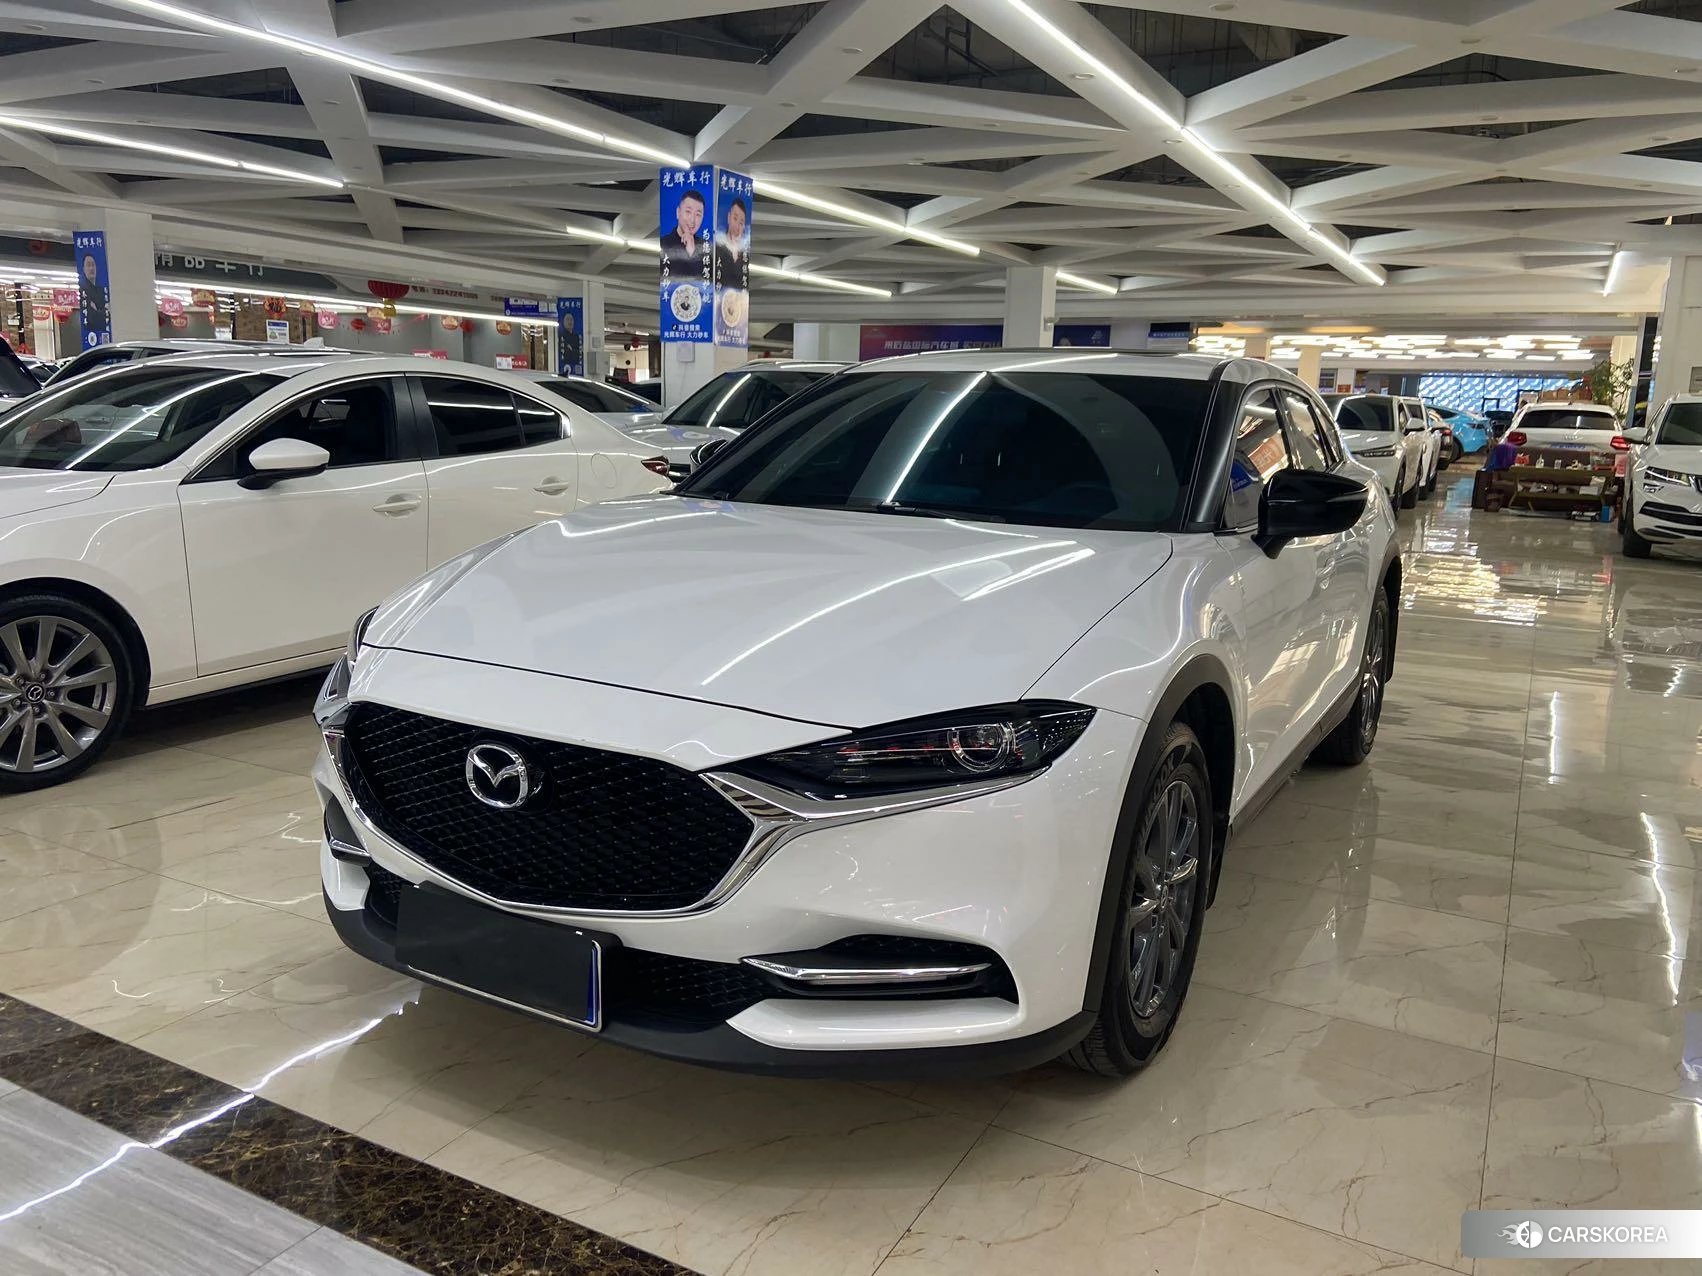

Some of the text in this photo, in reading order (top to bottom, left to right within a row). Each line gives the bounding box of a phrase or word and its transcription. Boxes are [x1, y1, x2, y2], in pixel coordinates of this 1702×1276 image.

[662, 170, 711, 188] 光辉车行
[720, 174, 752, 197] 光辉车行
